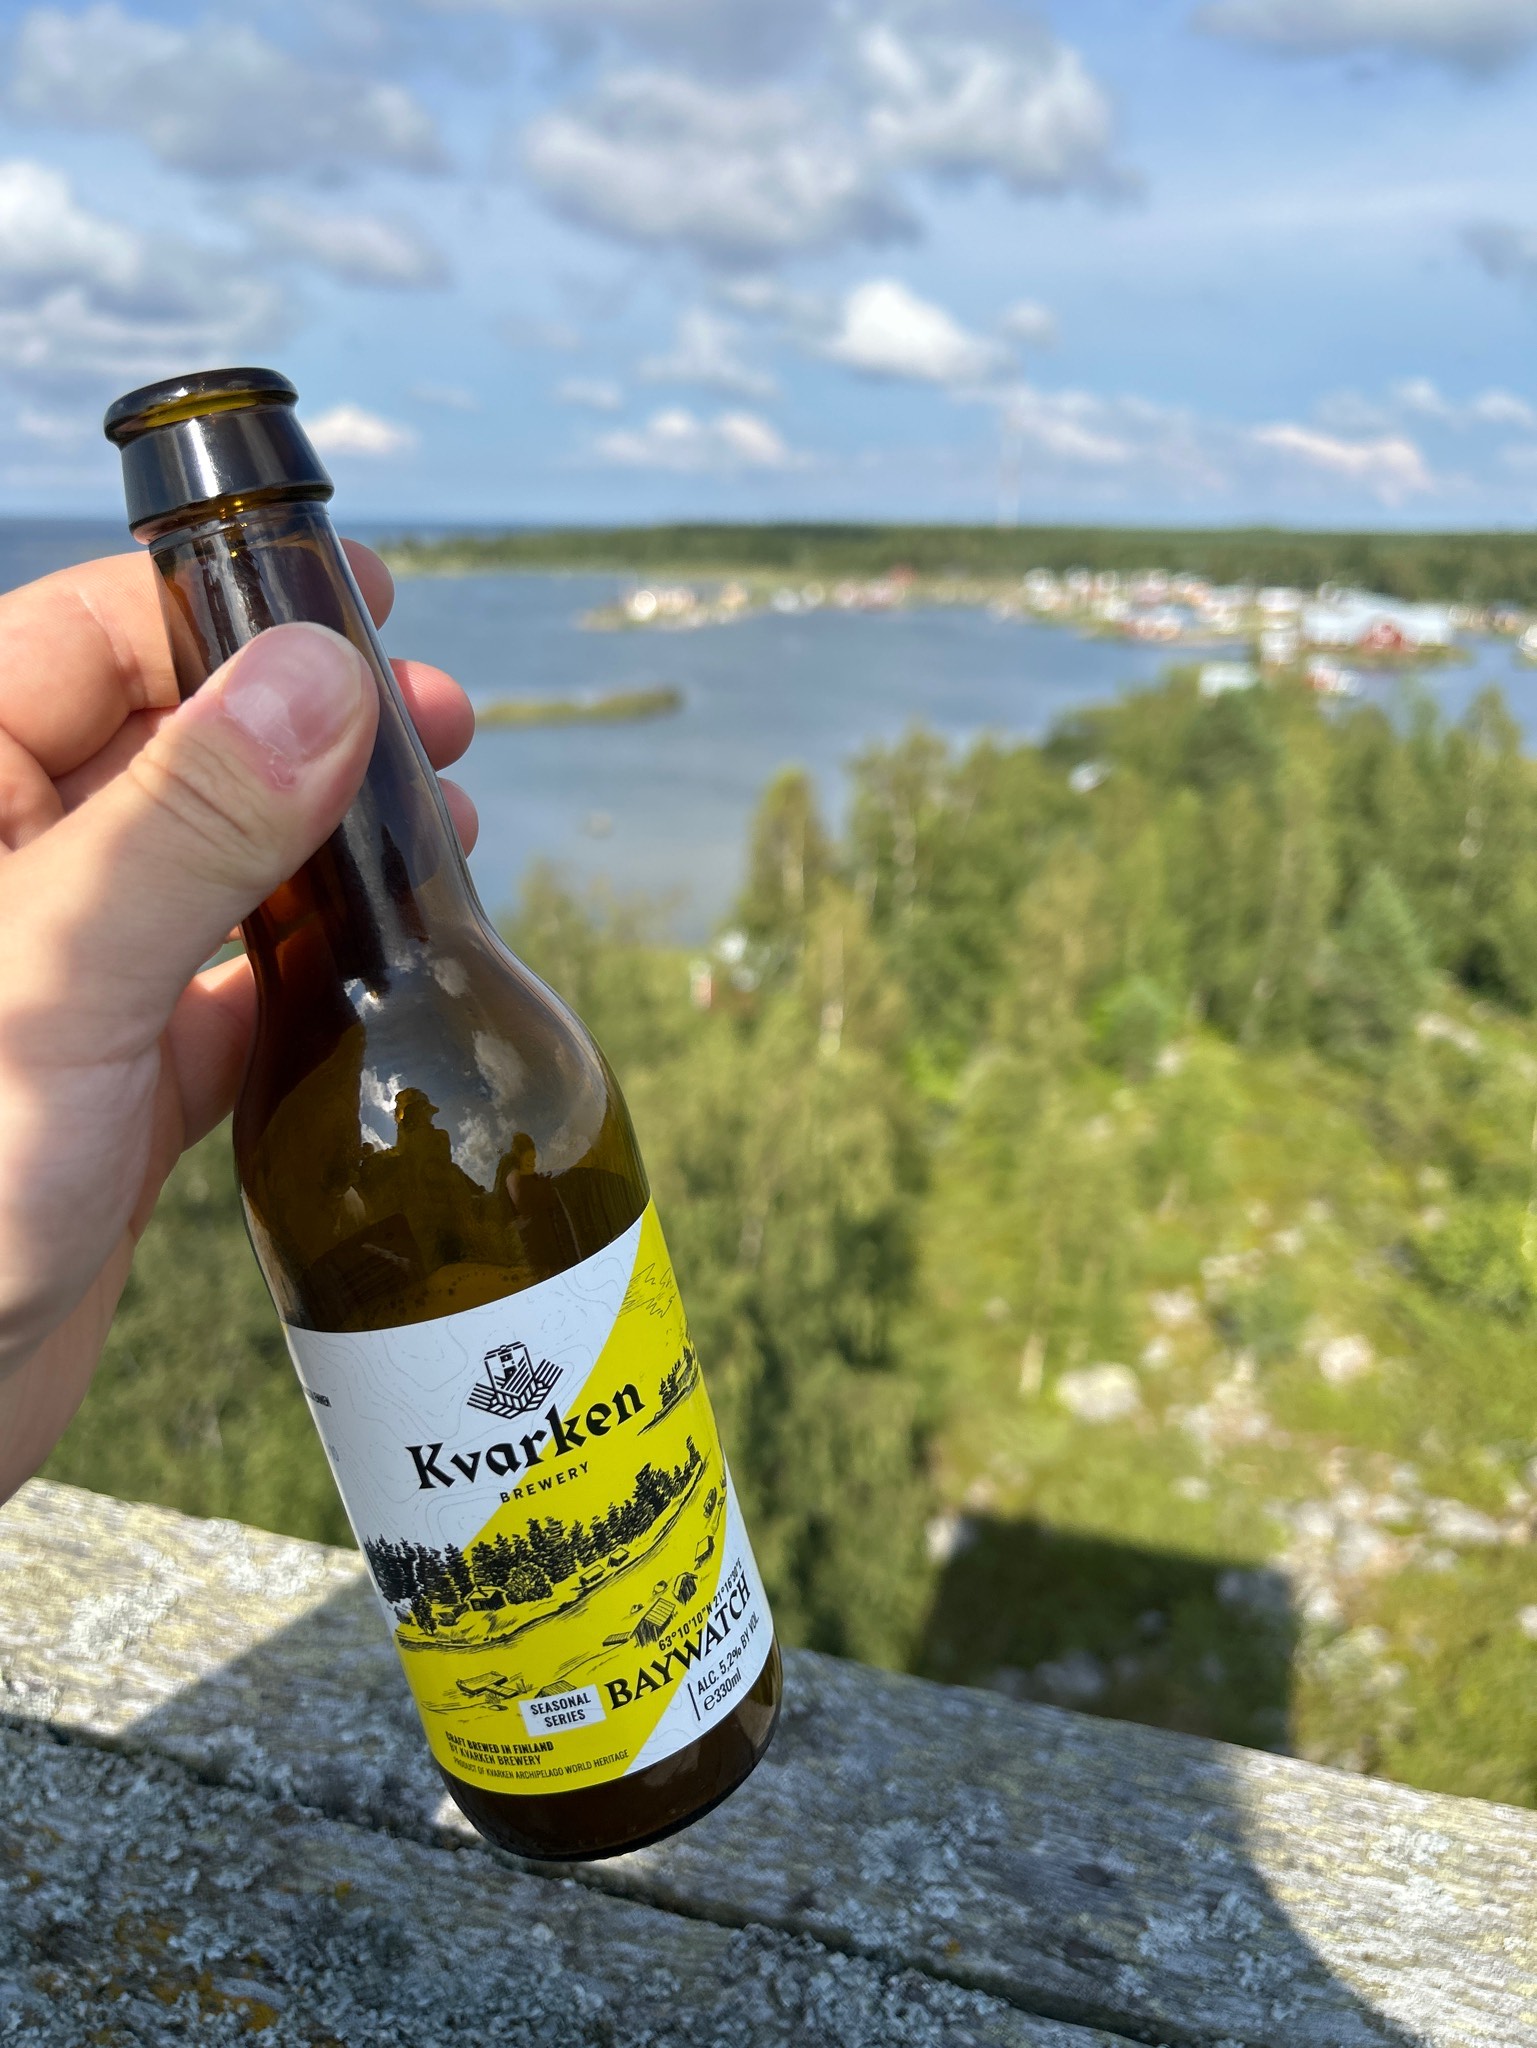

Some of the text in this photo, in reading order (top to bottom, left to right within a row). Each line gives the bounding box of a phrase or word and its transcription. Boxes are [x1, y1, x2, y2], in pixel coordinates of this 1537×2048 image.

[405, 1383, 645, 1490] Kvarken
[500, 1461, 590, 1503] BREWERY
[604, 1570, 751, 1710] BAYWATCH
[697, 1670, 719, 1695] ALC.
[719, 1646, 742, 1675] 5,2%
[740, 1627, 750, 1649] BY
[530, 1692, 591, 1716] SEASONAL
[544, 1709, 586, 1728] SERIES
[448, 1742, 541, 1766] BY KVARKEN BREWERY
[467, 1740, 500, 1754] BREWED
[500, 1744, 512, 1754] IN
[512, 1741, 554, 1754] FINLAND
[486, 1768, 514, 1779] KVARKEN
[515, 1767, 564, 1780] ARCHIPELAGO
[565, 1761, 592, 1775] WORLD
[594, 1749, 629, 1768] HERITAGE
